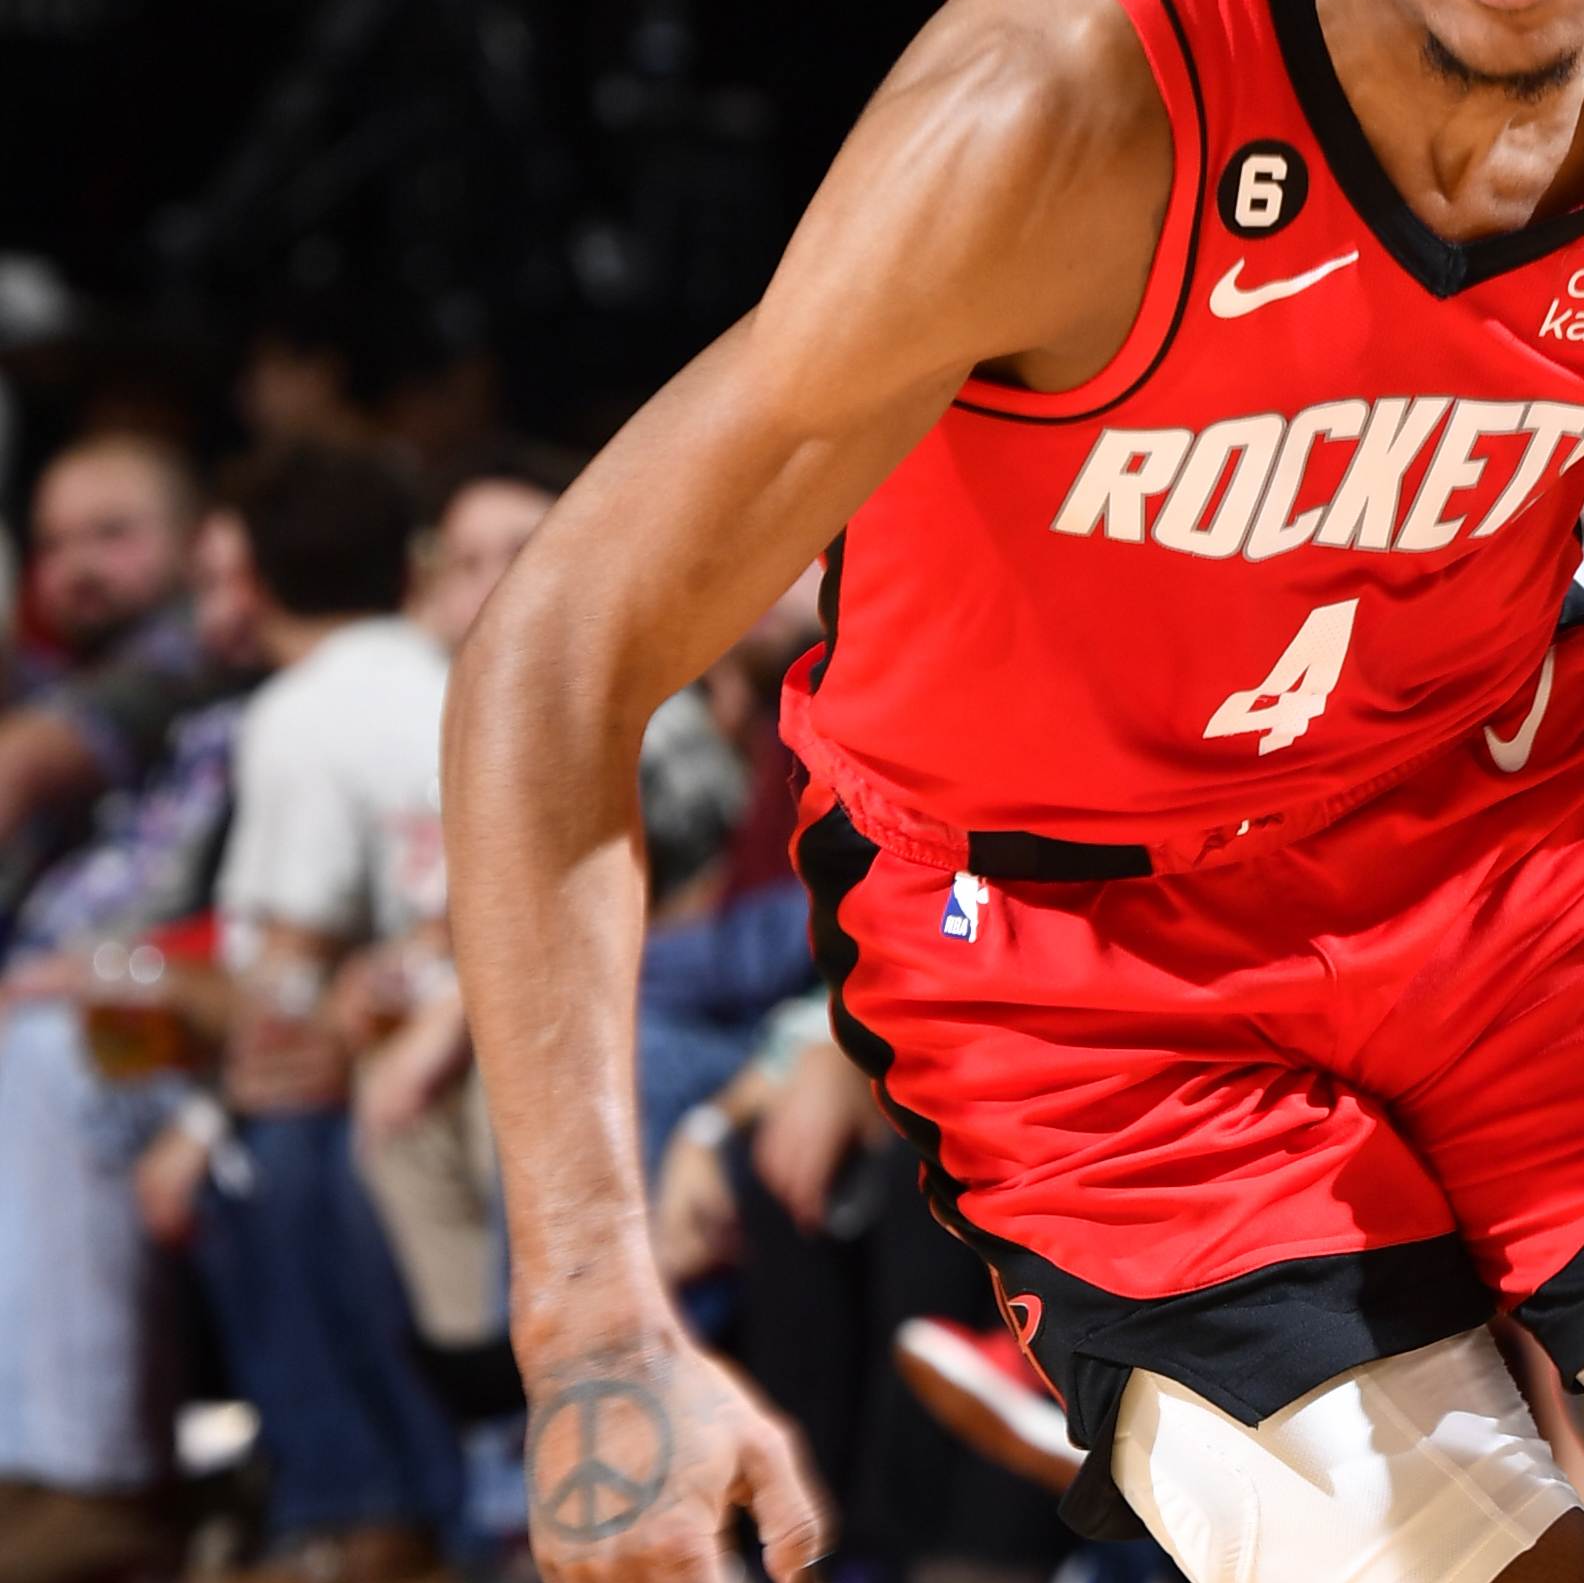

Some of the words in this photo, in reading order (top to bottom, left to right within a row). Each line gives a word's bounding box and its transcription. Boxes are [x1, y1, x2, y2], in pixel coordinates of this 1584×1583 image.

[1234, 154, 1288, 227] 6
[1202, 598, 1360, 756] 4
[944, 915, 968, 936] NBA
